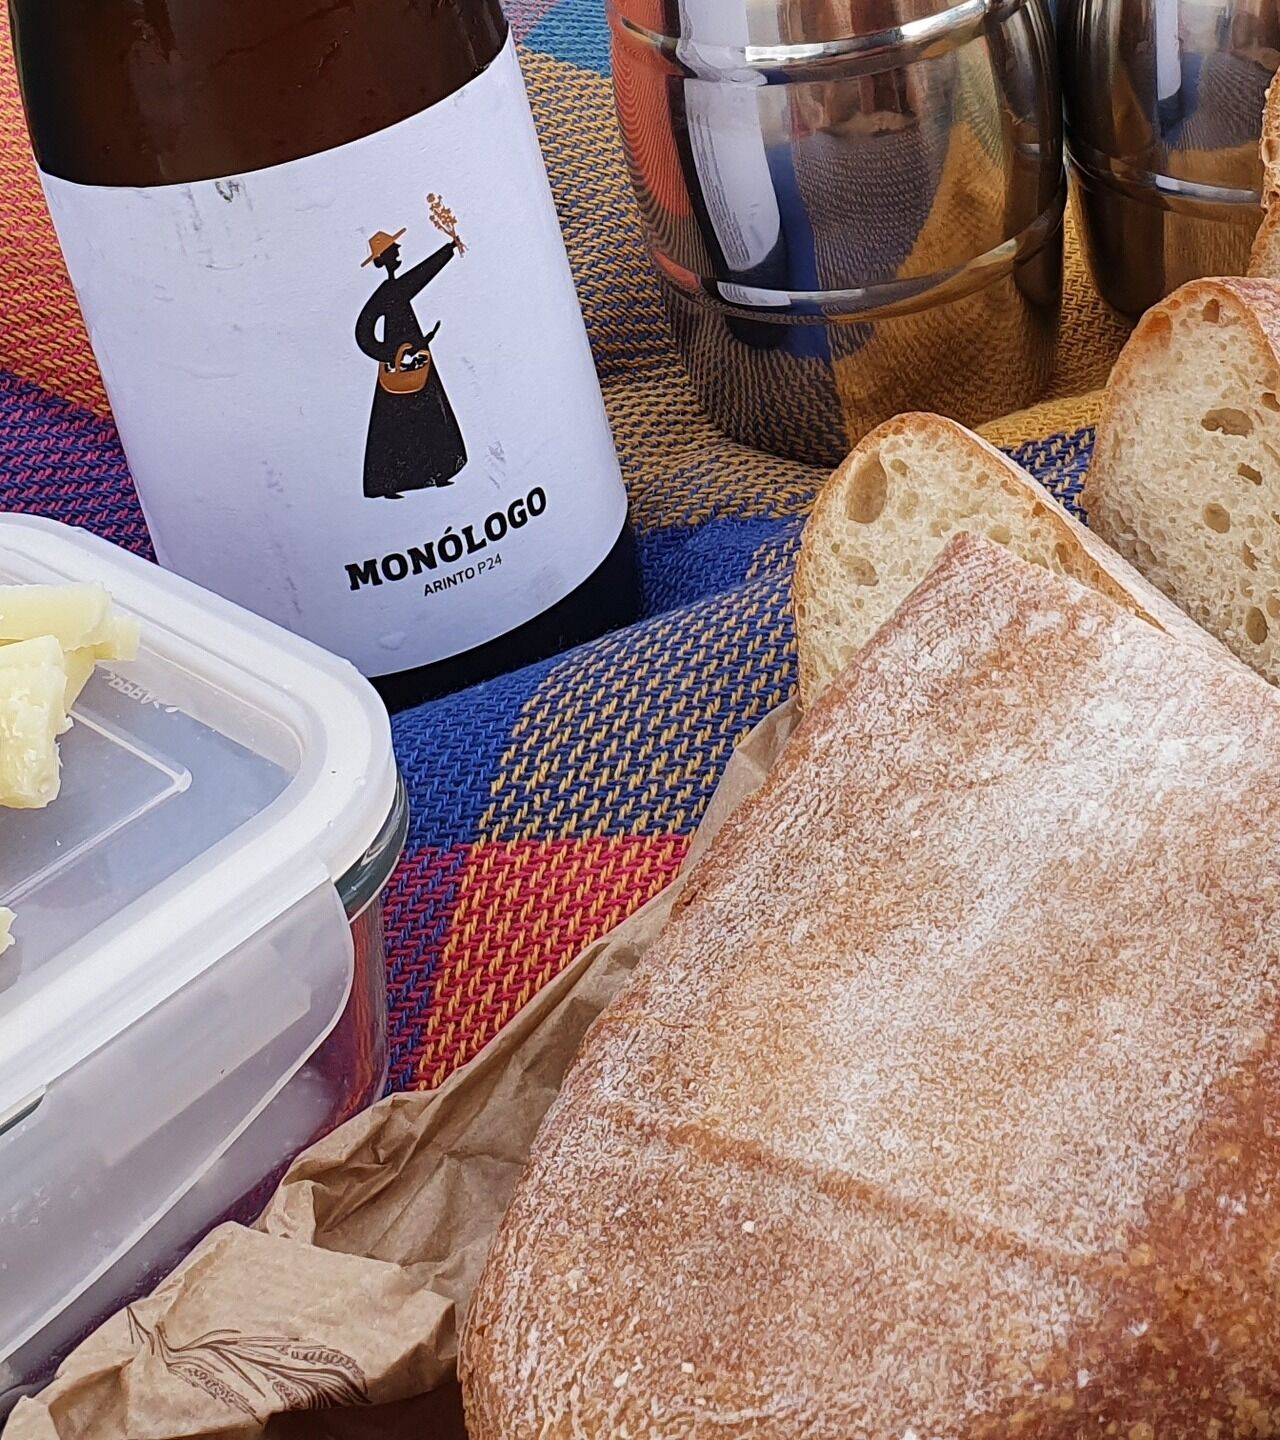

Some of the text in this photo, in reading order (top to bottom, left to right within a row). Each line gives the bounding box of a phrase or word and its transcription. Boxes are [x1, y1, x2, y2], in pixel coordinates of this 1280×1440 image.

[344, 486, 547, 592] MONÓLOGO
[423, 552, 503, 597] ARINTO P24
